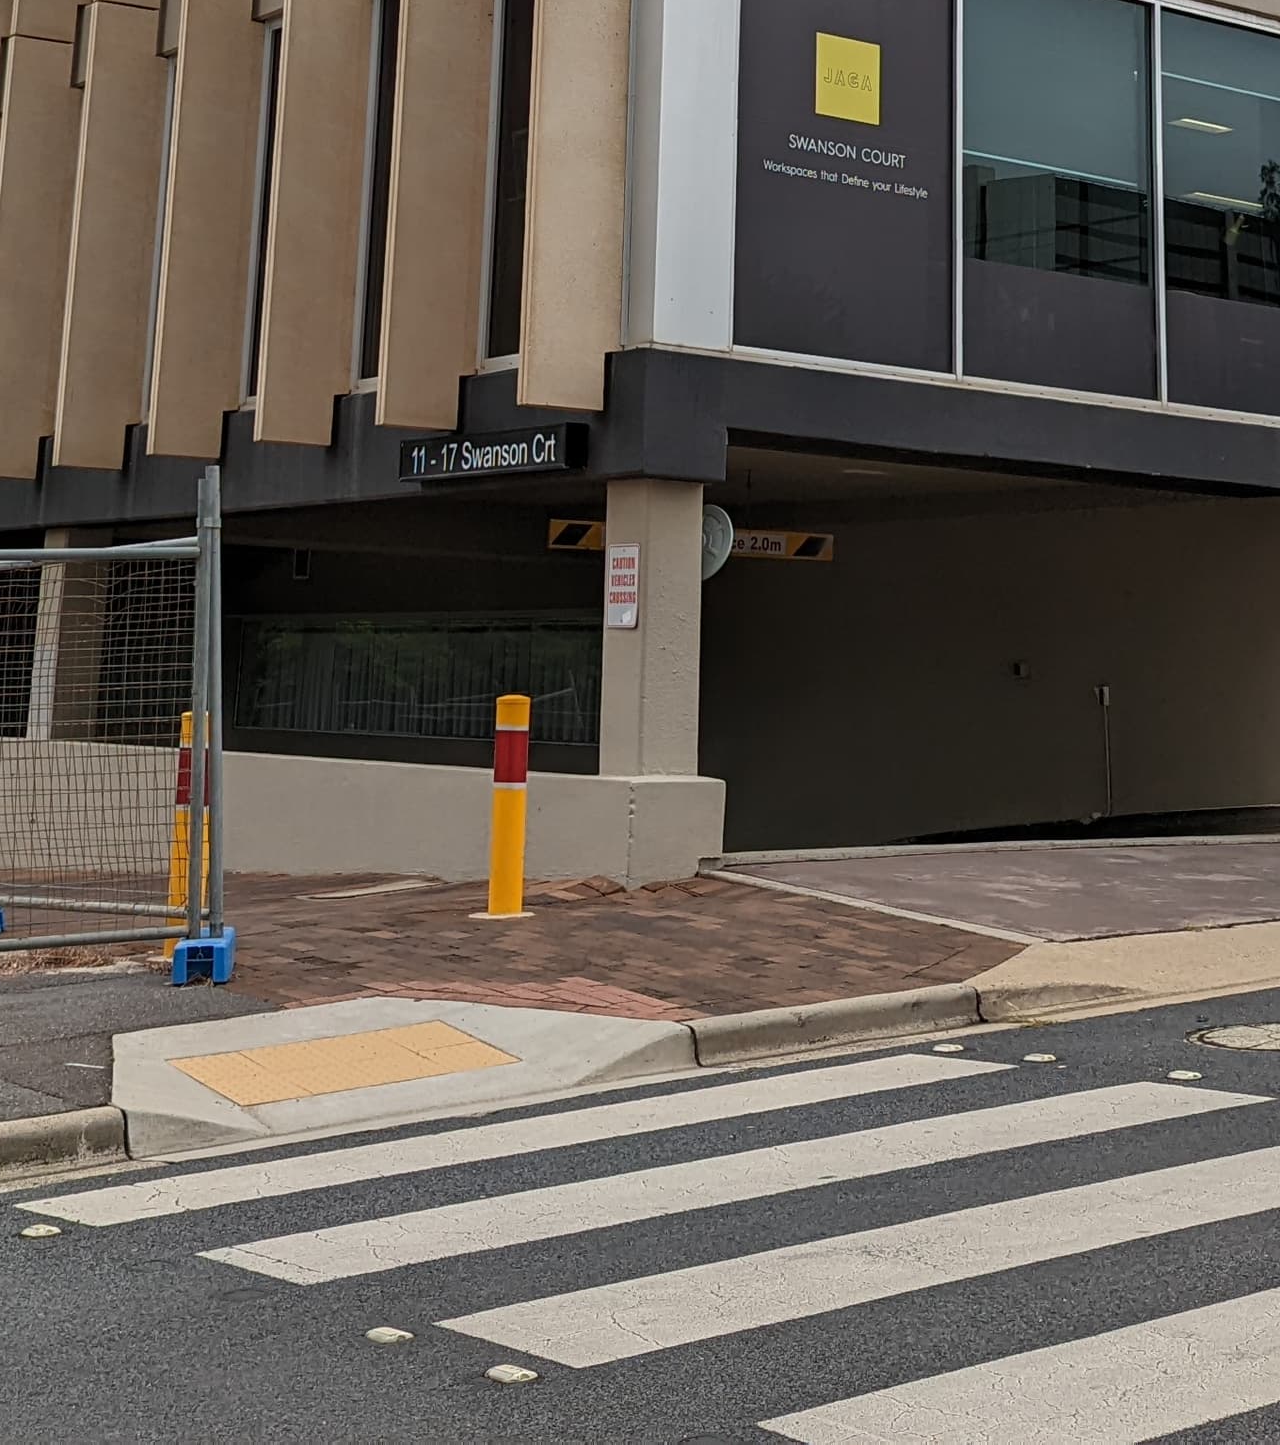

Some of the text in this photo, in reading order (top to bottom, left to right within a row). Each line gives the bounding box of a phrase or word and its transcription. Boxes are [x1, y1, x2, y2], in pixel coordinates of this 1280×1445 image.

[788, 134, 906, 169] SWANSON COURT
[763, 159, 928, 200] Workspaces that Define your Lifestyle
[411, 446, 426, 474] 11
[441, 443, 458, 471] 17
[461, 441, 528, 471] Swanson
[532, 433, 556, 463] Crt
[750, 536, 782, 552] 2.0m
[612, 557, 636, 570] CAUTION
[609, 591, 636, 604] CROSSING
